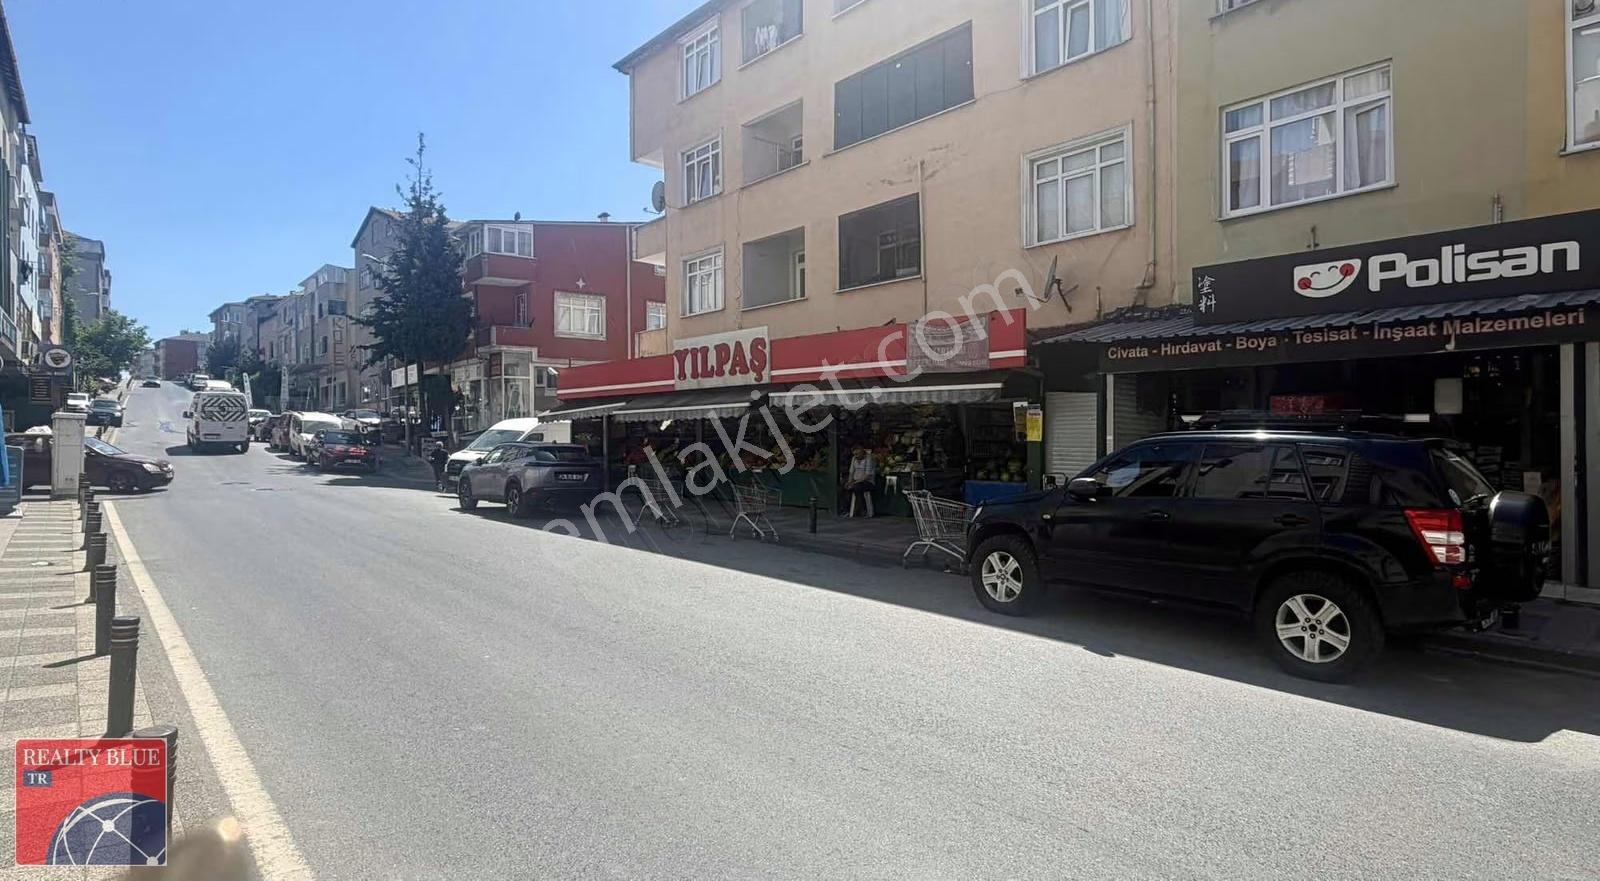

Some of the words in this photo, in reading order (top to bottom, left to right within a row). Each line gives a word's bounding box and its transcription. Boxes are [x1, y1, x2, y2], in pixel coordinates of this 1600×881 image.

[1368, 241, 1580, 292] Polisan
[1198, 275, 1217, 313] 塗料
[1108, 346, 1149, 360] Civata
[1160, 339, 1222, 356] Hırdavat
[1236, 336, 1277, 352] Boya
[1293, 328, 1358, 345] Tesisat
[1374, 322, 1436, 342] İnşaat
[1443, 308, 1585, 336] Malzemeleri
[673, 337, 767, 382] YILPAŞ
